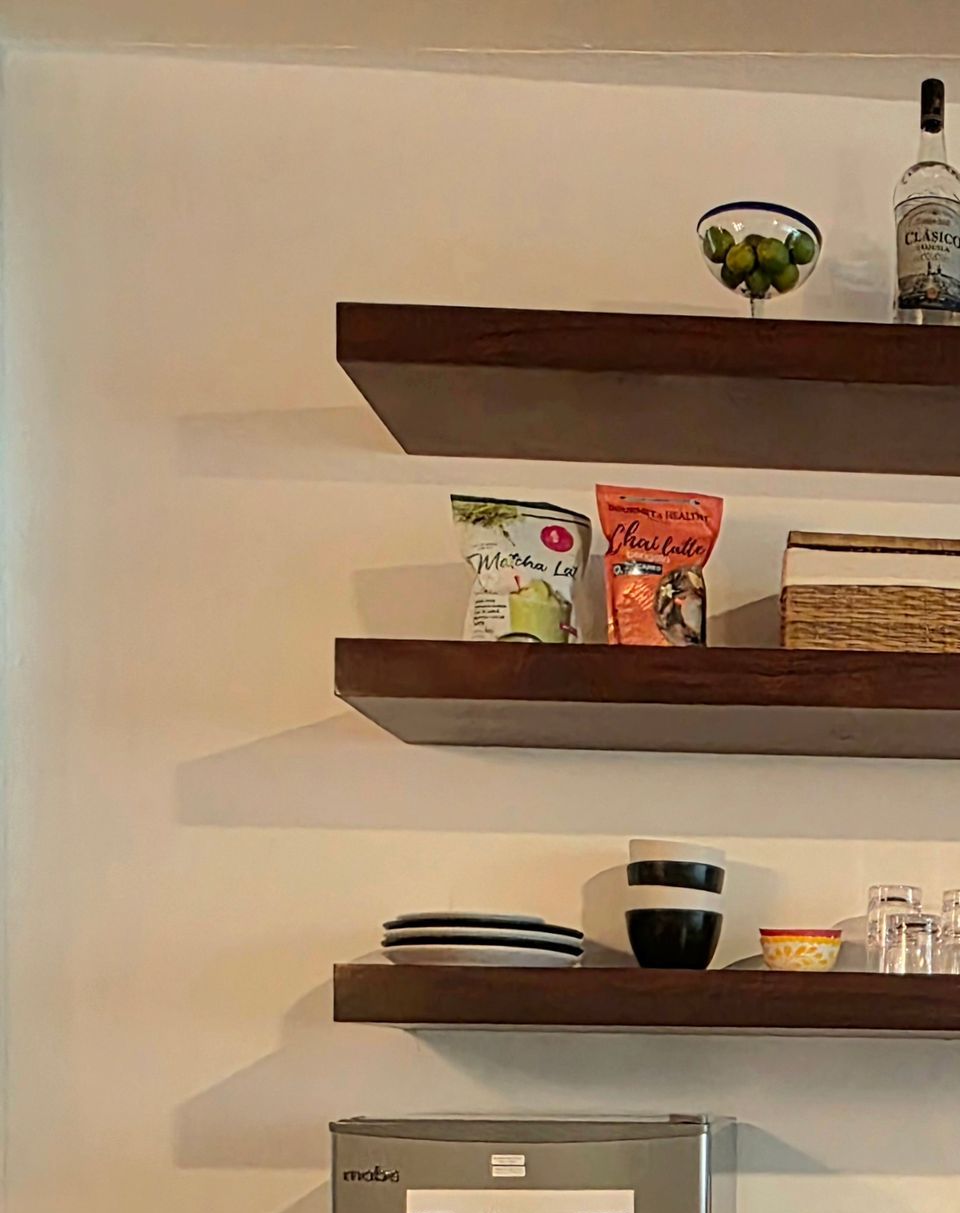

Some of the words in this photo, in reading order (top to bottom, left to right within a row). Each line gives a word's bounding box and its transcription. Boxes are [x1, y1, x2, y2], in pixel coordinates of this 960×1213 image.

[905, 228, 960, 249] CLÁSICO
[606, 520, 660, 555] Chai
[467, 552, 547, 574] Matcha
[343, 1166, 400, 1182] mabe
